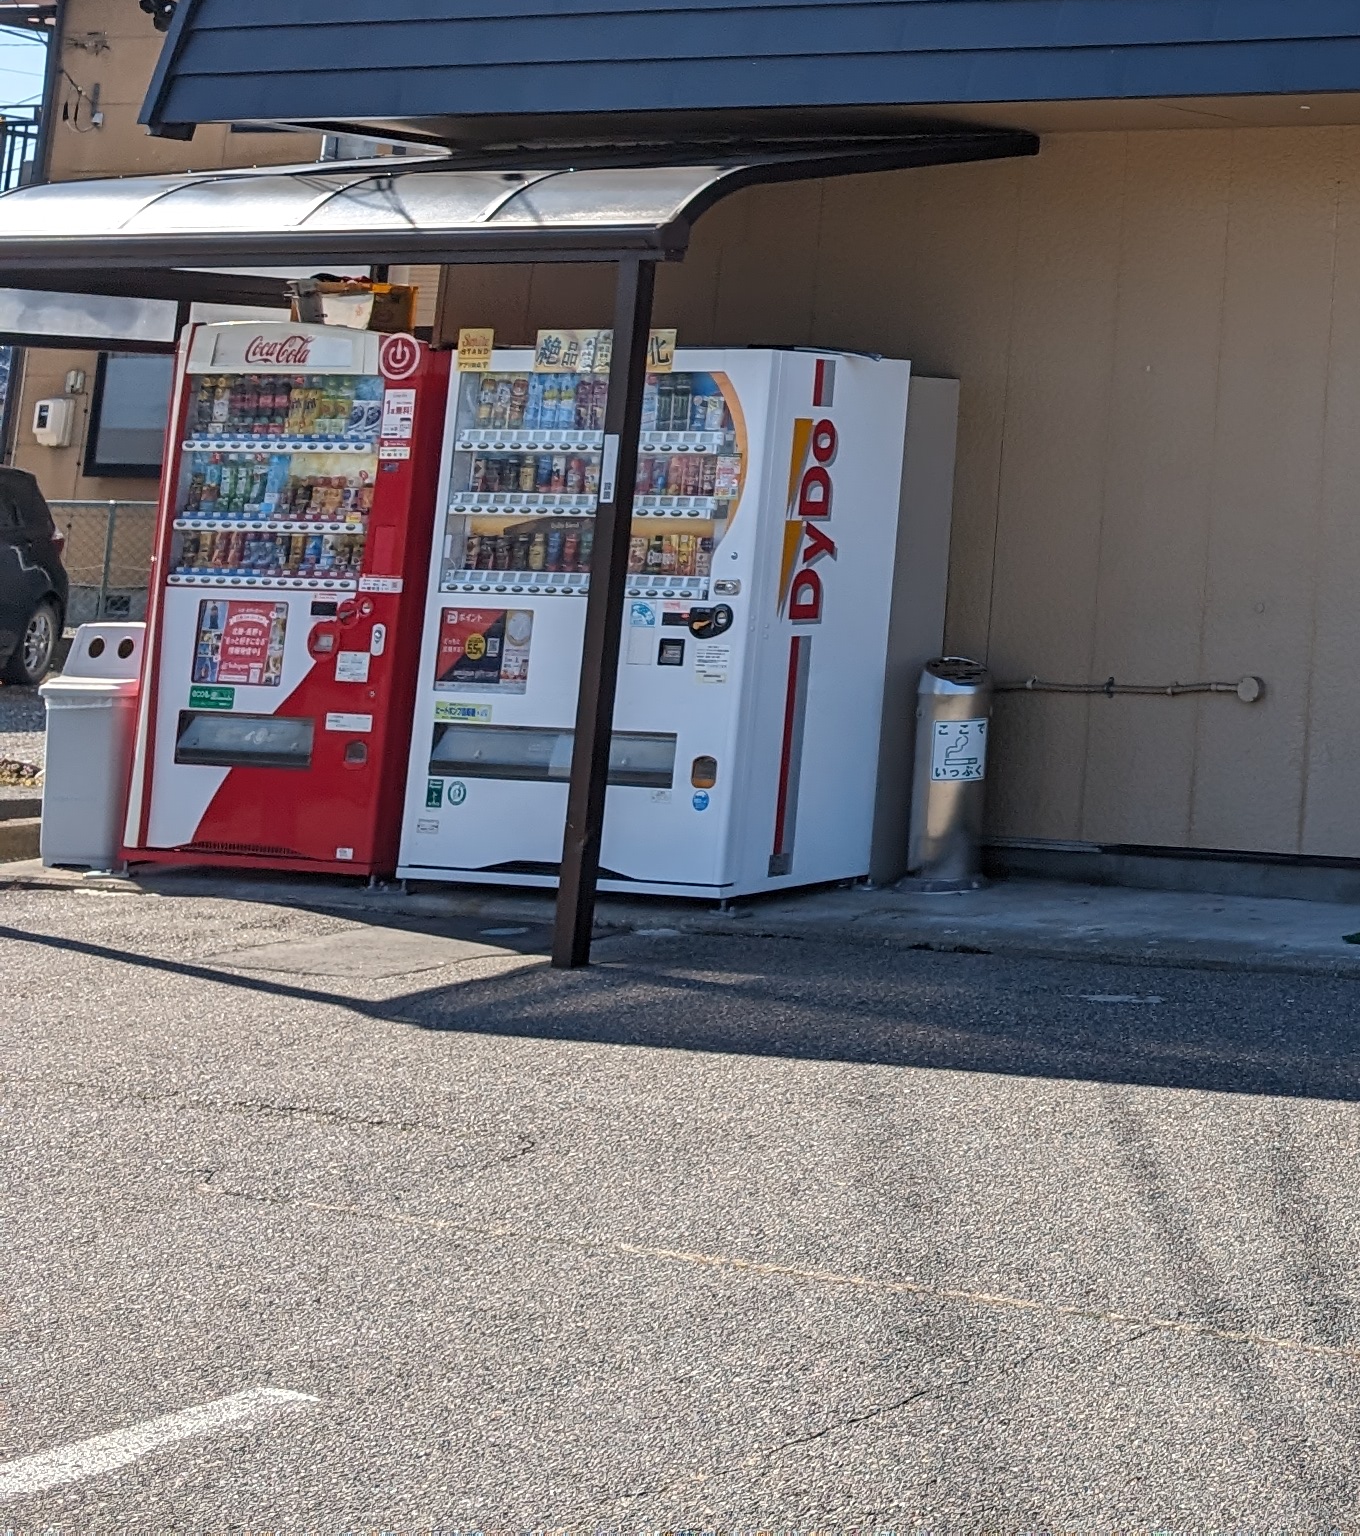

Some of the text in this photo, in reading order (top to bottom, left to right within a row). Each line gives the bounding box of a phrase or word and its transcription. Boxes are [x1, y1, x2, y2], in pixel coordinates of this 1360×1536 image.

[244, 335, 316, 364] Coca-Cola
[938, 723, 986, 735] ここで
[935, 765, 982, 777] いっぷく
